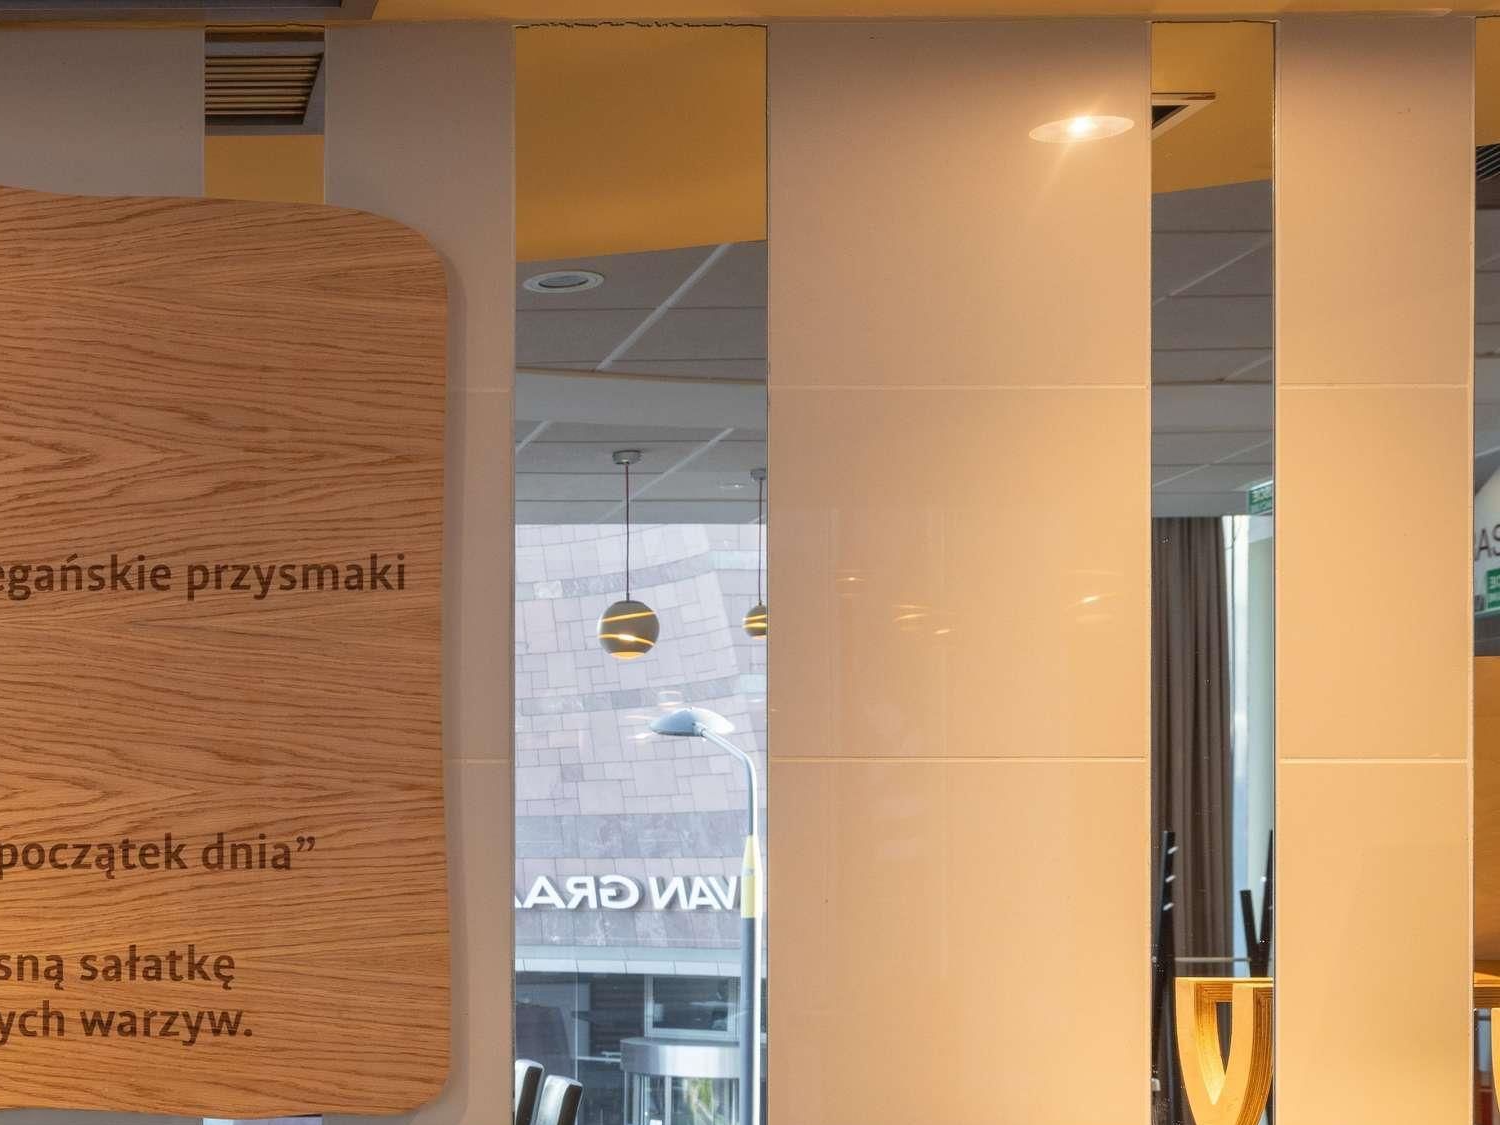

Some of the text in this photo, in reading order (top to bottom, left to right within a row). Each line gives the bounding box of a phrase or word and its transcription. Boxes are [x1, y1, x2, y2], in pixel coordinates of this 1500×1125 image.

[187, 553, 406, 601] przysmaki
[79, 944, 236, 991] sałatkę
[79, 1009, 253, 1047] warzyw.
